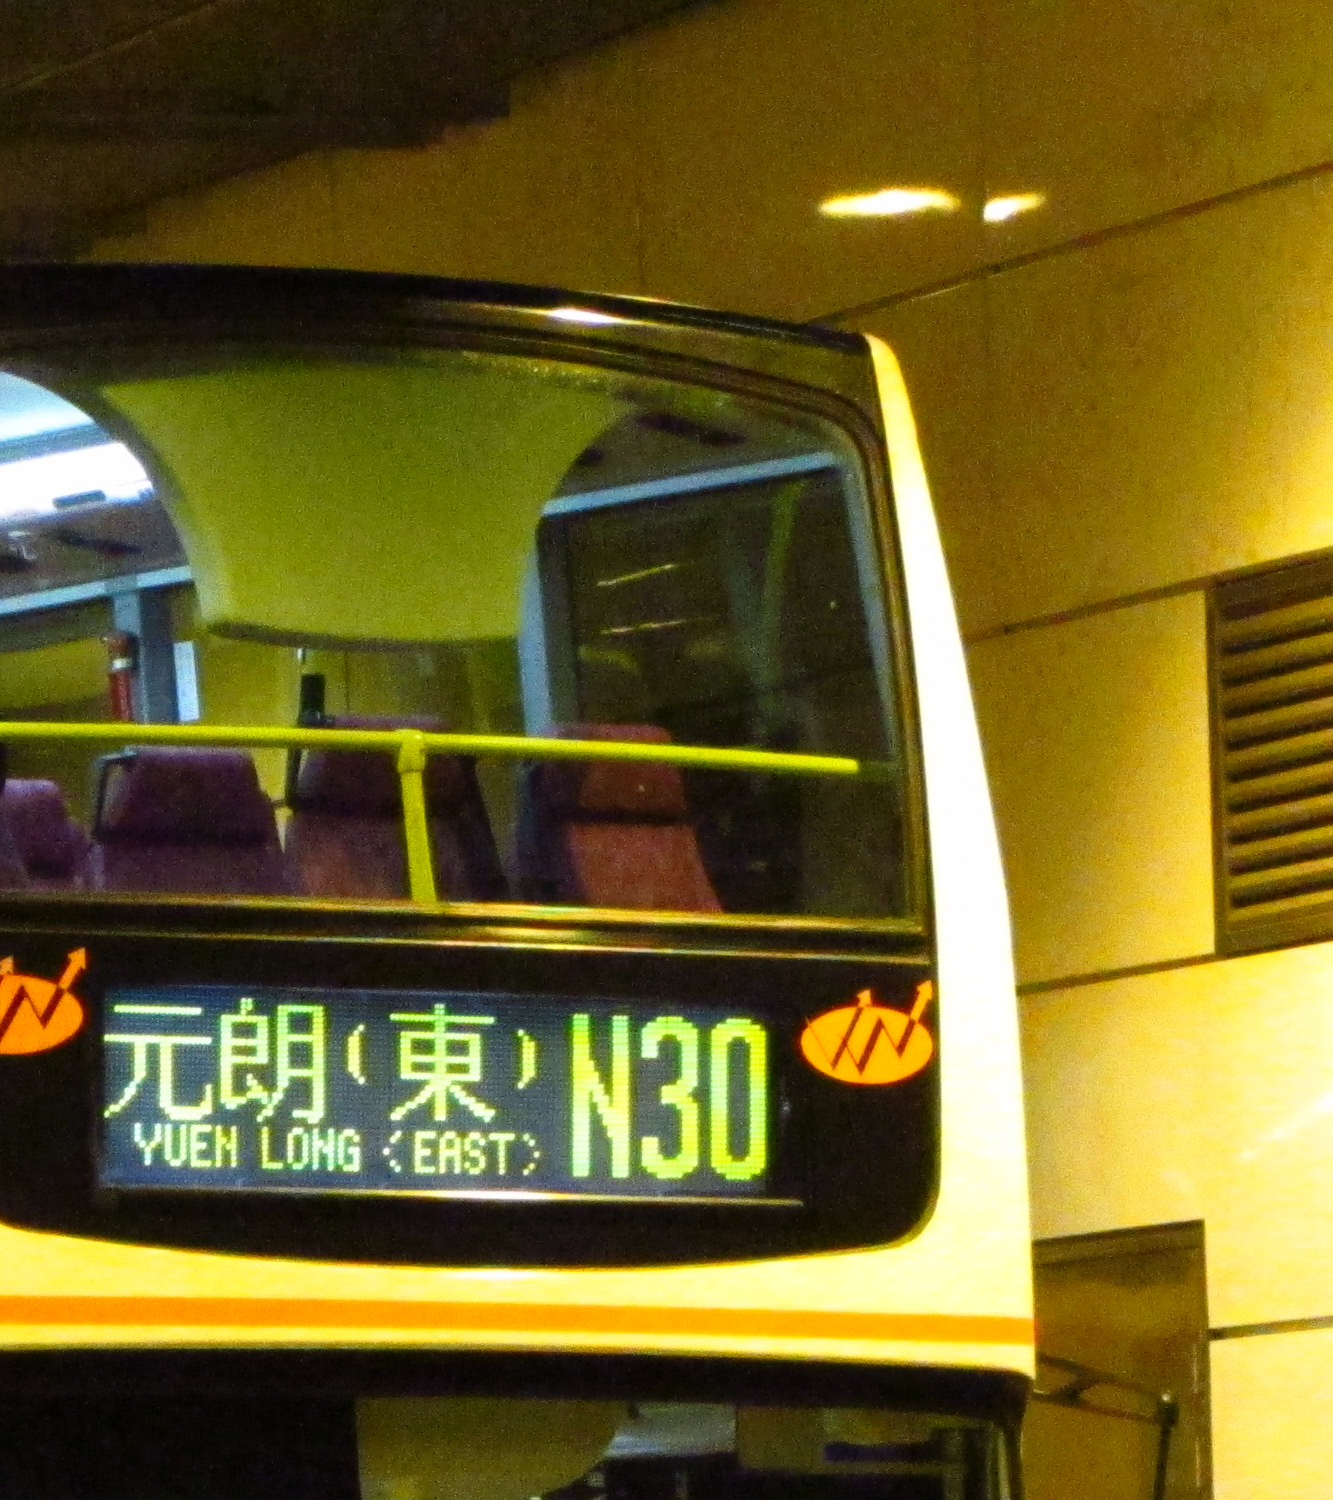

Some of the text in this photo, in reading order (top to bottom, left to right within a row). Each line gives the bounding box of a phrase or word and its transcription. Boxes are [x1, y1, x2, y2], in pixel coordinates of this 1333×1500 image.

[134, 1122, 541, 1175] YUEN LONG (EAST)
[571, 1013, 767, 1181] N30
